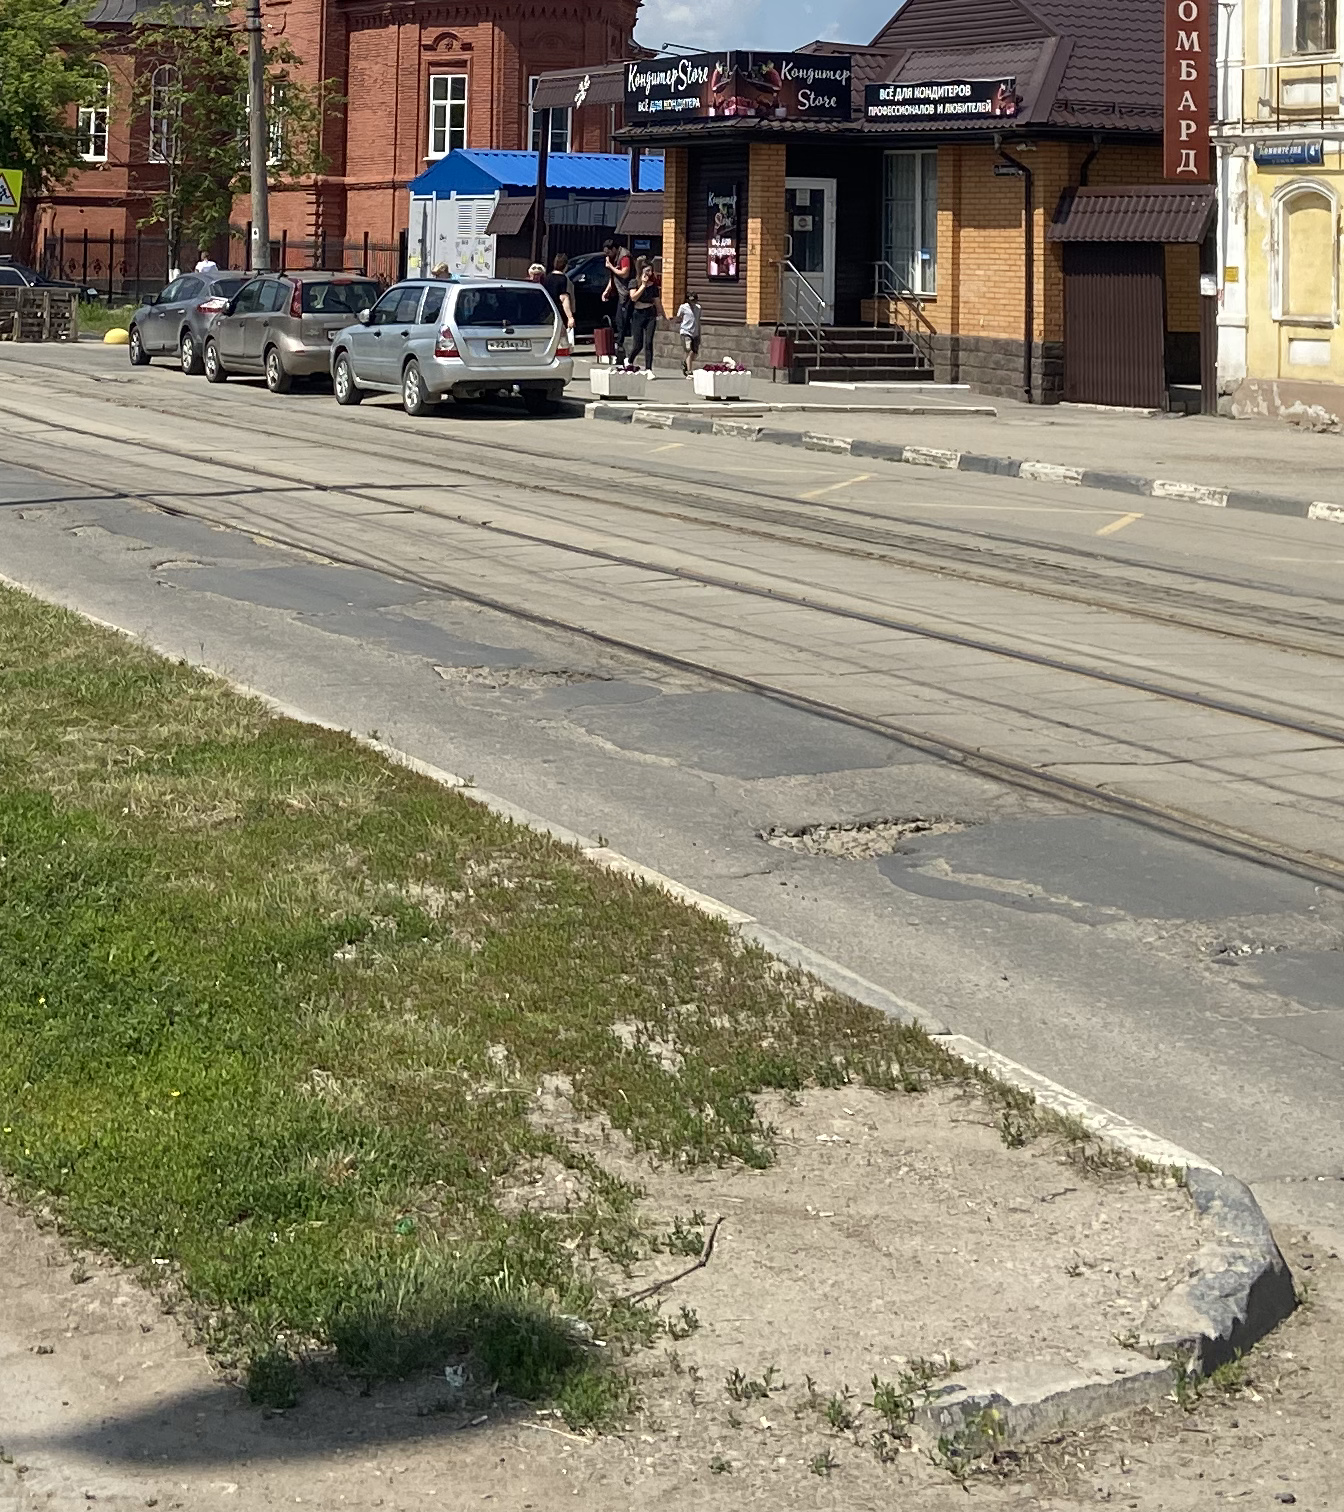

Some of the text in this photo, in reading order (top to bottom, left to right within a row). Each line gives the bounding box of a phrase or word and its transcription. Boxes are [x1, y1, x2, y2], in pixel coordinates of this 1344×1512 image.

[781, 60, 851, 85] Кондитер
[797, 89, 837, 110] Store
[879, 85, 972, 101] ВСЁ ДЛЯ КОНДИТЕРОВ
[649, 99, 662, 113] ДЛЯ
[663, 97, 700, 111] КОНДИТЕРА
[868, 100, 992, 116] ПРОФЕССИОНАЛОВ И ЛЮБИТЕЛЕЙ
